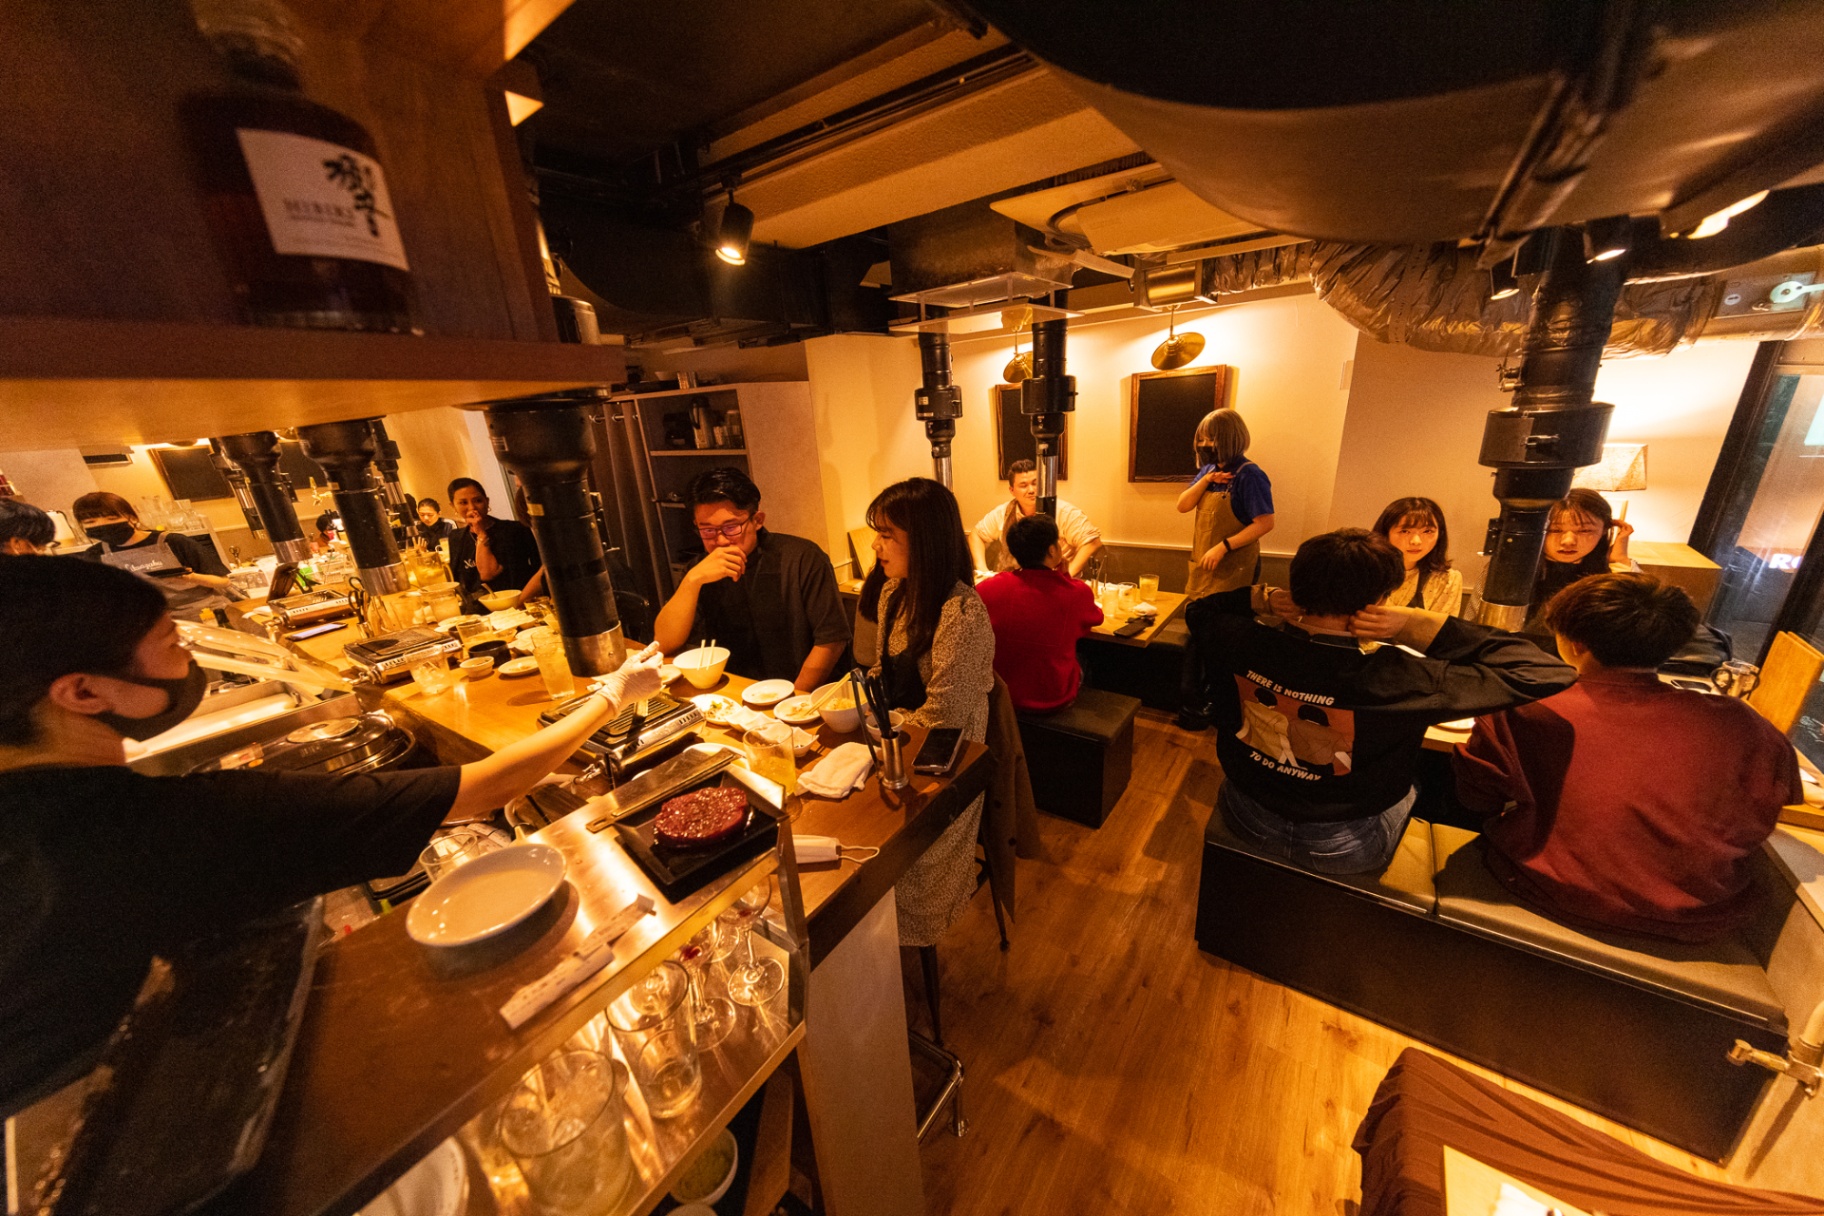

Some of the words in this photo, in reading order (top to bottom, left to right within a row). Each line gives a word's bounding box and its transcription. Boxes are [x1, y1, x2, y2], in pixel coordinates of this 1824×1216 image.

[1246, 669, 1273, 689] THERE
[1273, 683, 1283, 693] IS
[1284, 688, 1335, 706] NOTHING
[1249, 751, 1262, 761] TO
[1261, 759, 1275, 769] DO
[1277, 765, 1322, 781] ANYWAY
